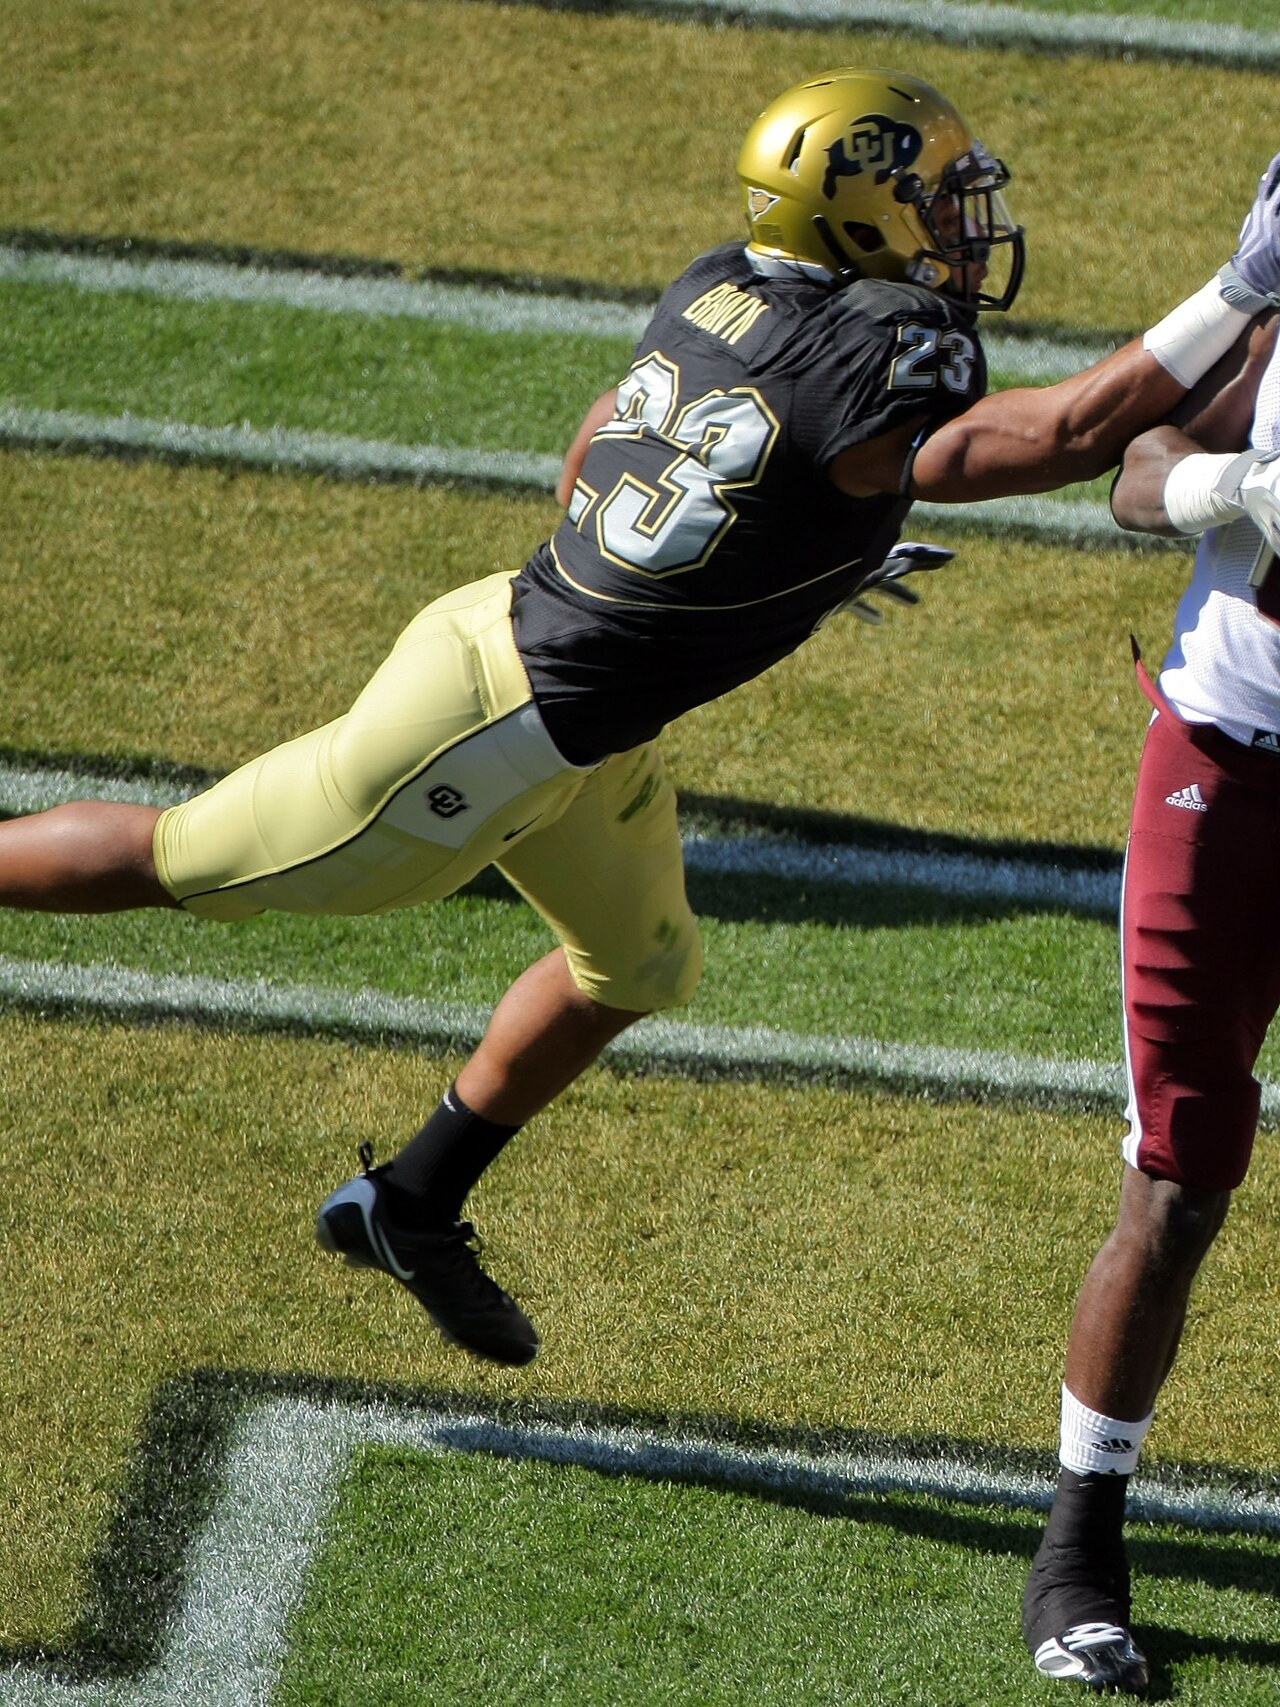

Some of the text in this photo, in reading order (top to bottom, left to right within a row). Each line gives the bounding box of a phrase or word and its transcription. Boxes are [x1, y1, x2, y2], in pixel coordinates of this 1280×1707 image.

[843, 121, 895, 170] CU
[887, 320, 977, 394] 23
[1164, 797, 1208, 812] adidas
